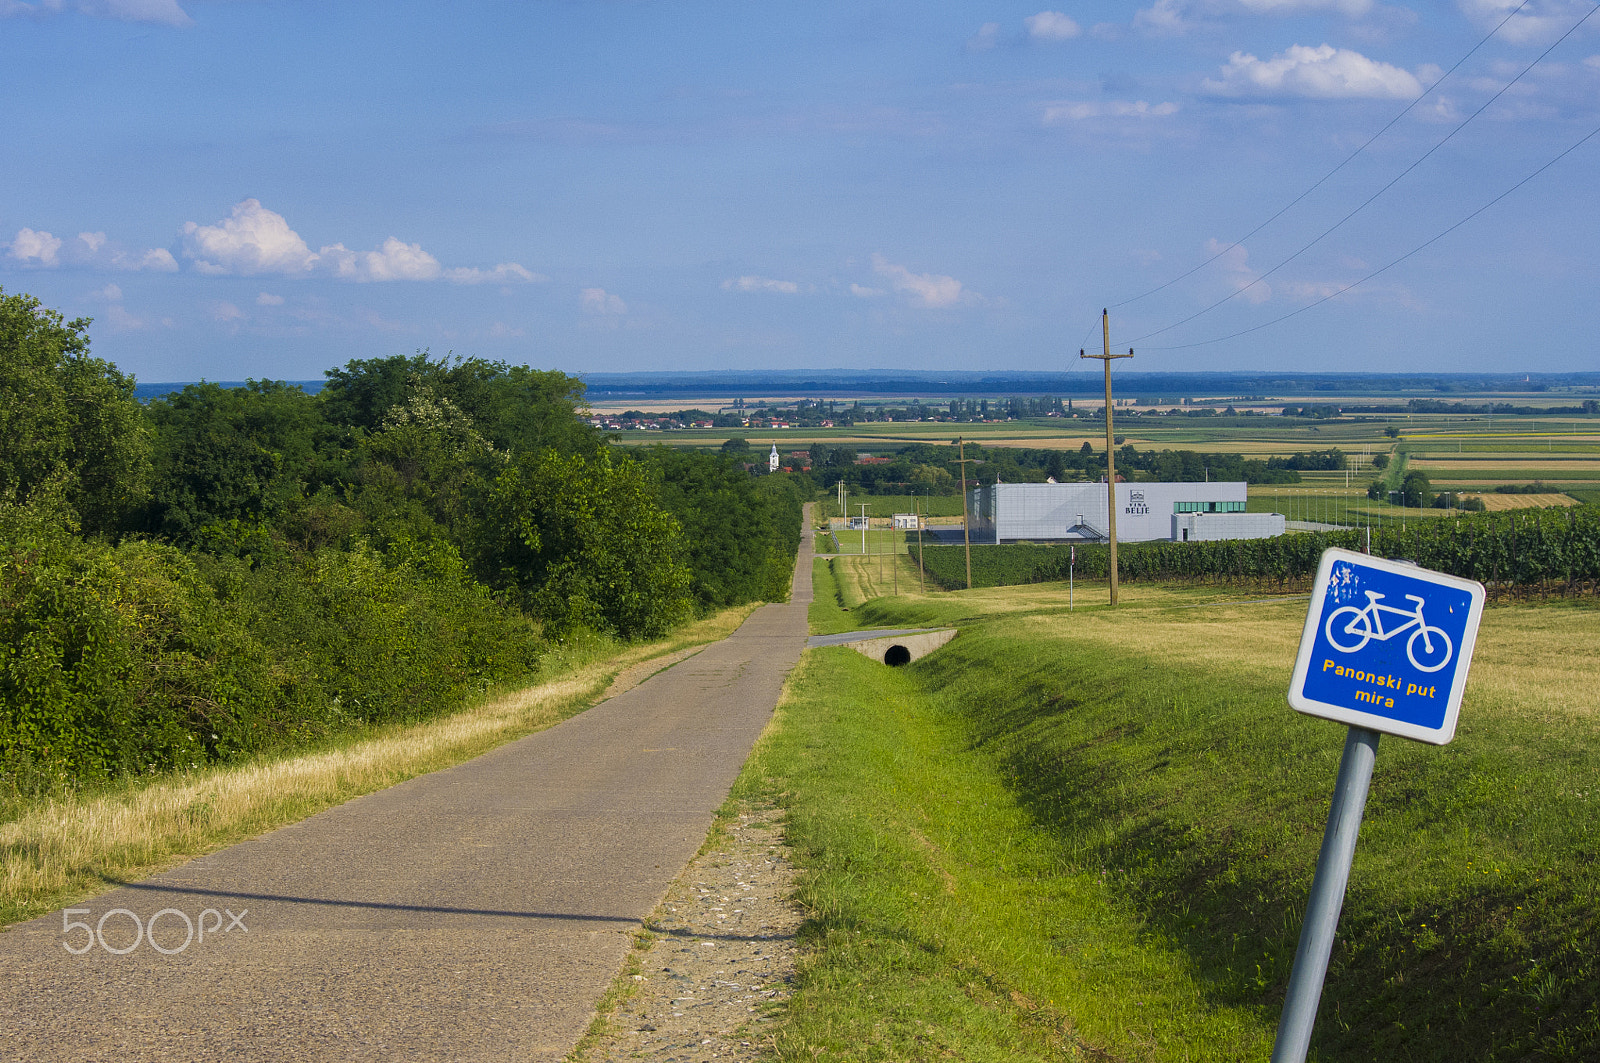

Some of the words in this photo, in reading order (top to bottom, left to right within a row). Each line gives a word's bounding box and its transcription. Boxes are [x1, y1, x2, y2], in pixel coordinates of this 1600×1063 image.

[1322, 659, 1402, 690] Panonski
[1406, 683, 1436, 698] put
[1355, 690, 1395, 708] mira
